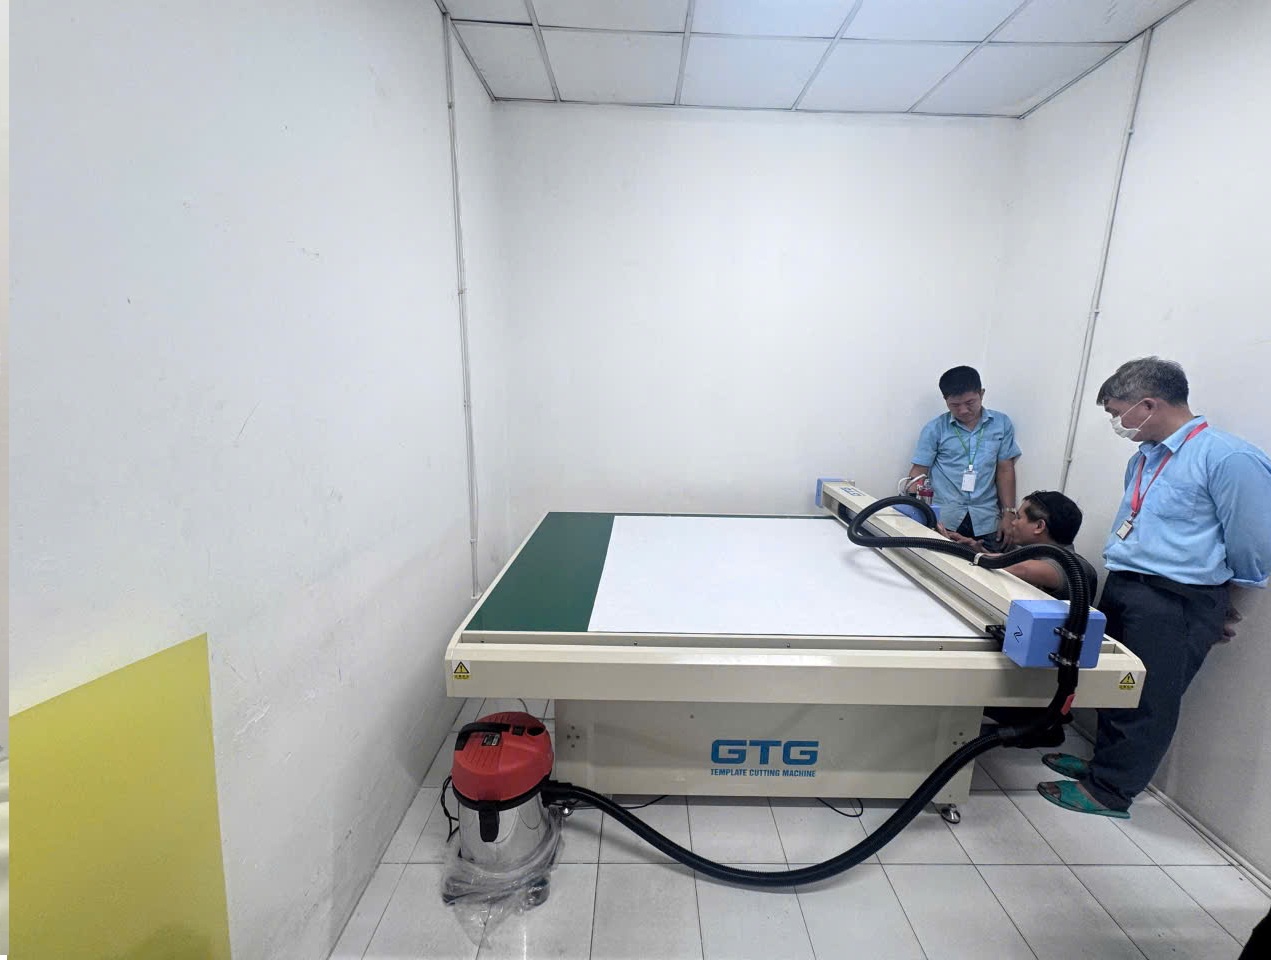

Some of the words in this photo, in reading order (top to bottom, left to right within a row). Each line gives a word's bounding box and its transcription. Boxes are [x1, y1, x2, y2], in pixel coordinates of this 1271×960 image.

[711, 739, 819, 766] GTG
[710, 768, 747, 776] TEMPLATE
[749, 769, 780, 777] CUTTING
[782, 769, 816, 778] MACHINE
